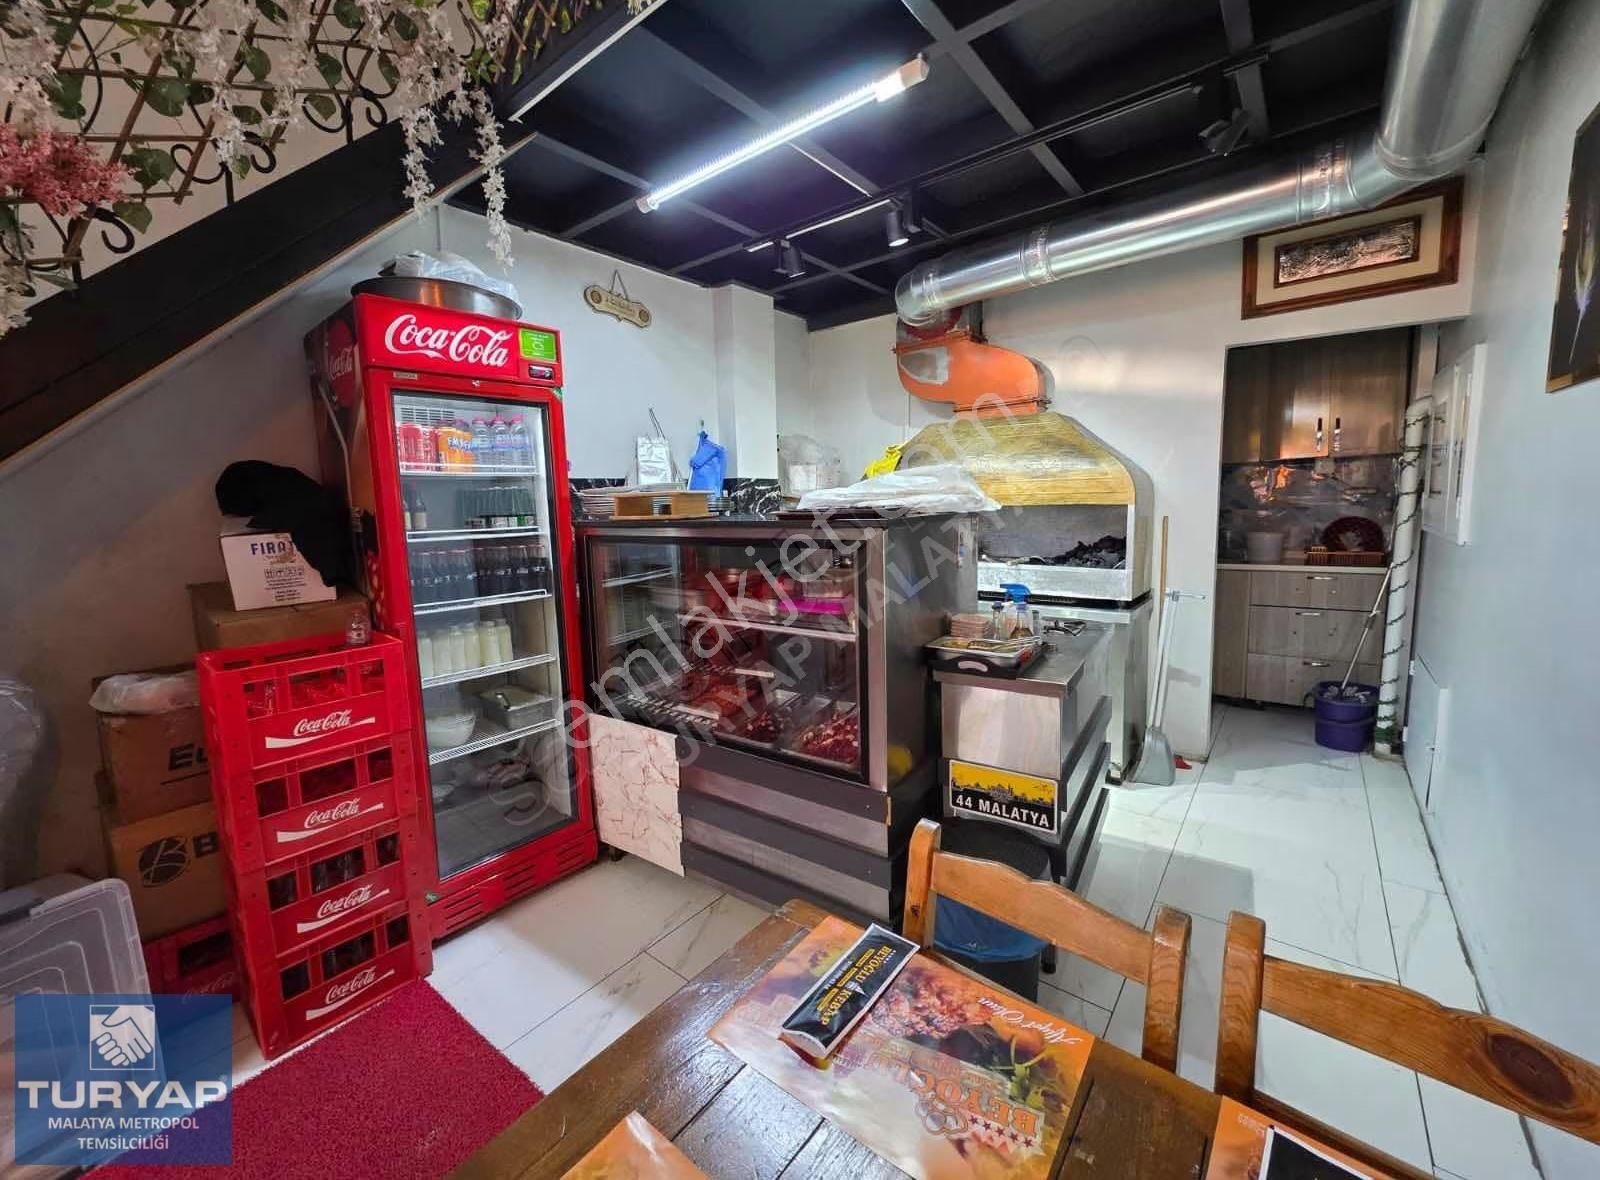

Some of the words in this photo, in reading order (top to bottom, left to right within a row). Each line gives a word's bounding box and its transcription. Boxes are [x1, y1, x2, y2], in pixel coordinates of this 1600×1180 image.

[384, 314, 513, 367] Coca-Cola
[294, 709, 352, 737] Coca-Cola
[304, 798, 360, 829] Coca-Cola
[956, 795, 972, 808] 44
[979, 799, 1049, 828] MALATYA
[317, 884, 373, 919] Coca-Cola
[325, 966, 376, 1004] Coca-Cola
